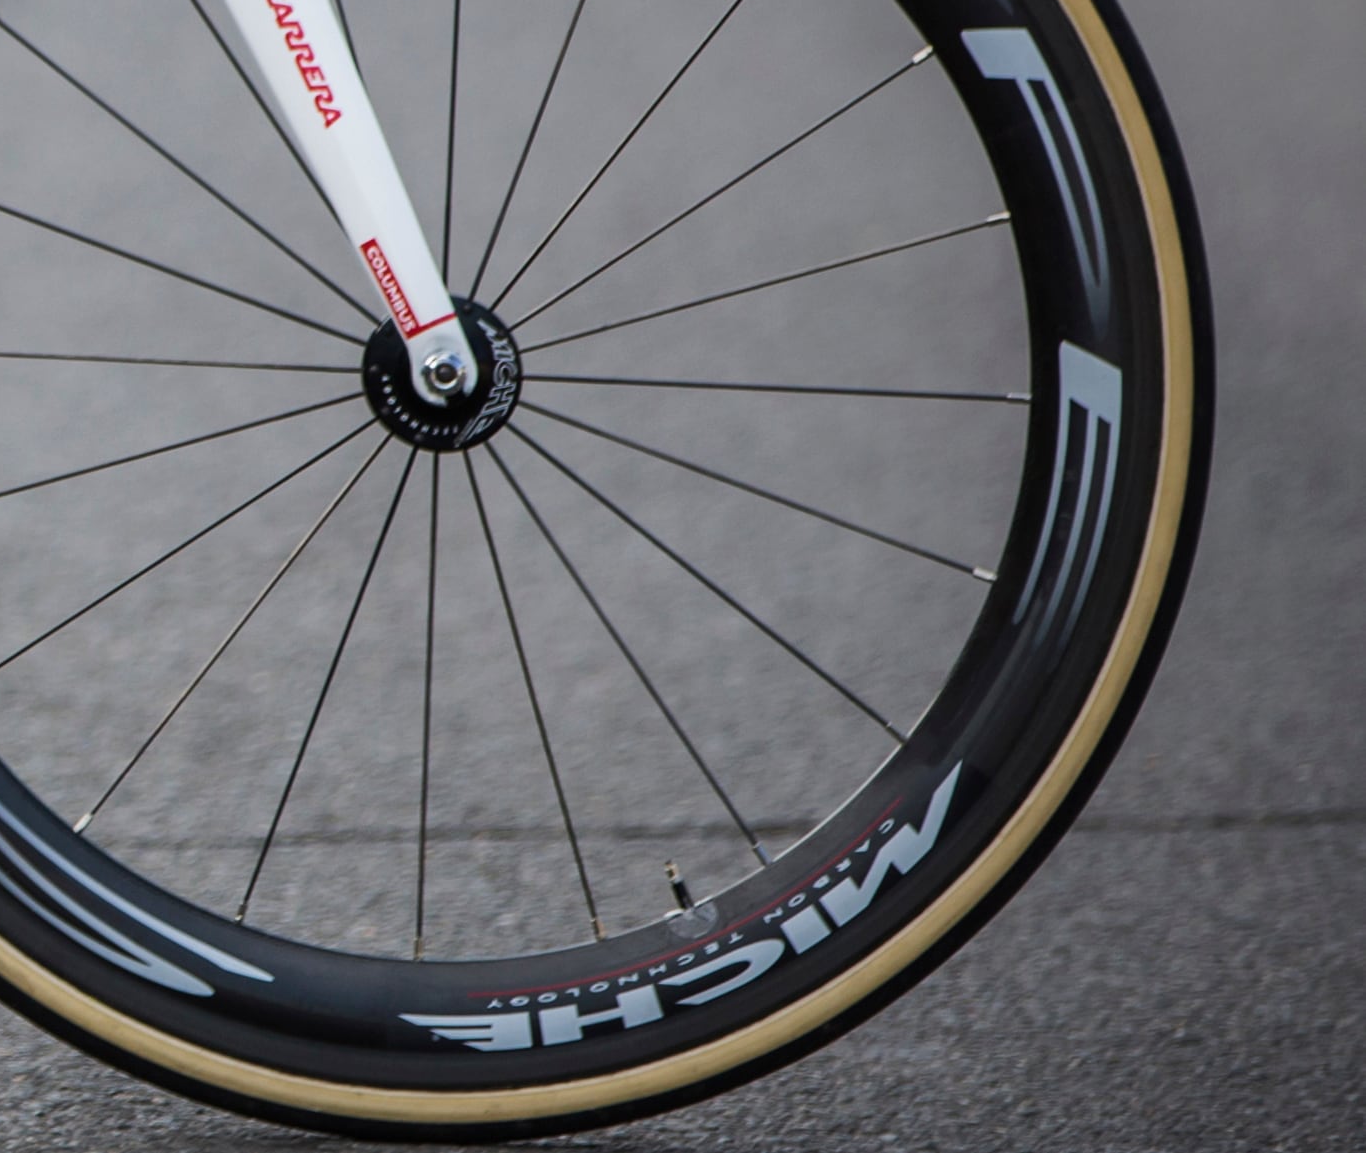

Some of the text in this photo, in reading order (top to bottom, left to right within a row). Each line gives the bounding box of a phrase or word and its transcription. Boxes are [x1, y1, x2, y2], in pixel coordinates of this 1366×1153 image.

[366, 245, 417, 335] COLUMBUS
[397, 759, 964, 1052] MICHE
[486, 817, 895, 1010] CARBON TECHNOLOGY
